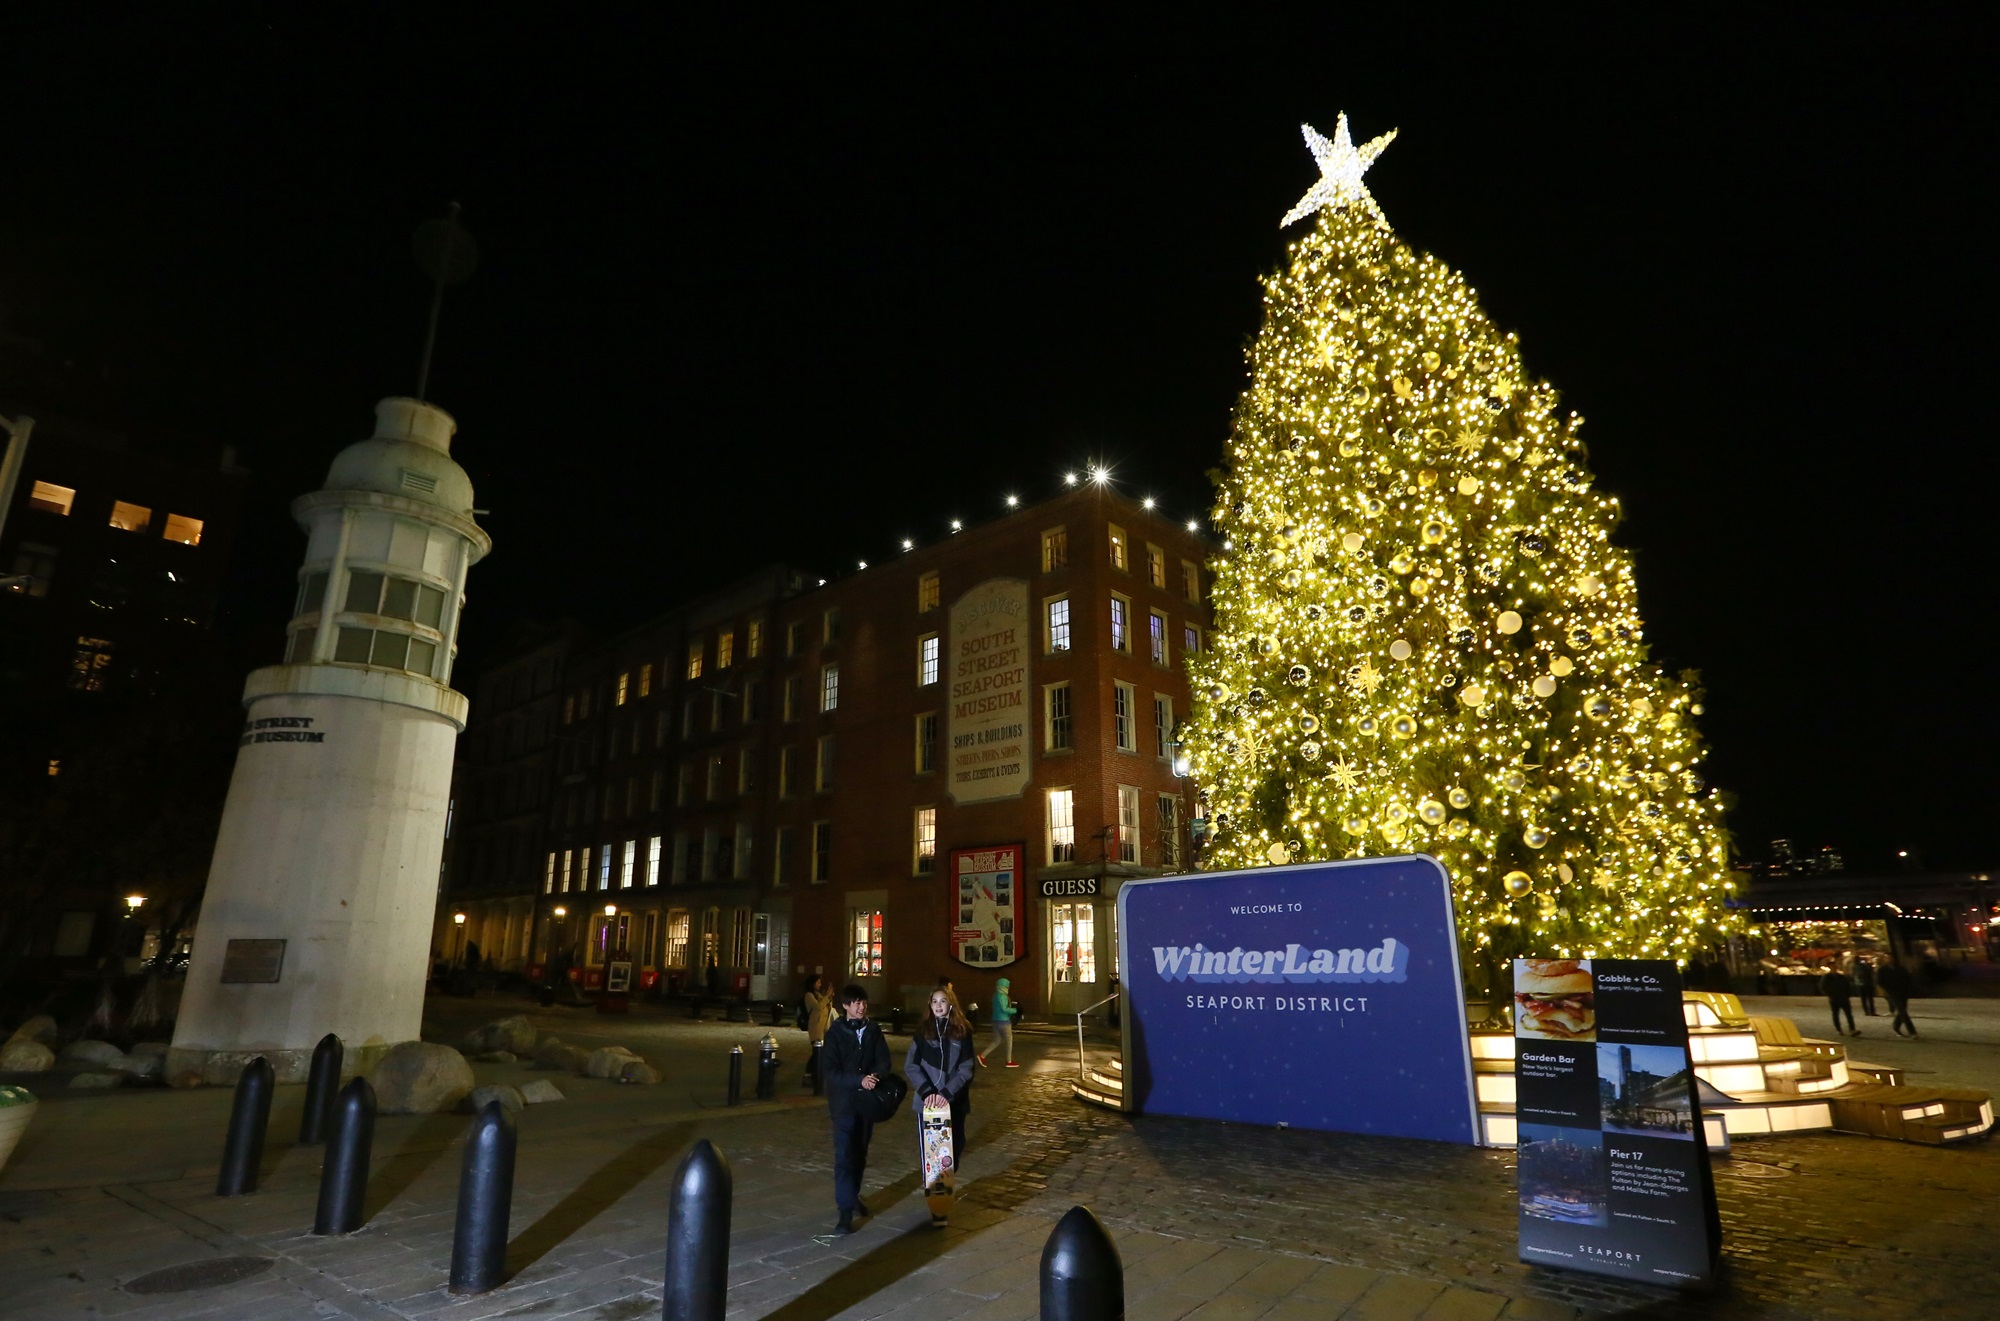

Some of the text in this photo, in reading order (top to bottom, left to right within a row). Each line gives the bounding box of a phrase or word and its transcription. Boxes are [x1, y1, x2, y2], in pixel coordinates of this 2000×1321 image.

[961, 628, 1016, 657] SOUTH
[957, 648, 1019, 677] STREET
[953, 668, 1025, 698] SEAPORT
[954, 690, 1022, 719] MUSEUM
[254, 731, 325, 743] MUSEUM
[954, 723, 1023, 749] SHIPS & BUILDINGS
[1043, 878, 1096, 896] GUESS
[1231, 903, 1302, 915] WELCOME TO
[1152, 937, 1408, 983] WinterLand
[1598, 974, 1632, 983] Cobble
[1642, 975, 1659, 984] Co.
[1186, 995, 1368, 1012] SEAPORT DISTRICT
[1522, 1052, 1575, 1064] Garden Bar
[1610, 1149, 1643, 1160] Pier 17
[1636, 1171, 1667, 1182] including
[1668, 1175, 1680, 1183] The
[1663, 1168, 1685, 1177] dining
[1611, 1176, 1632, 1184] Fulton
[1642, 1180, 1689, 1192] Jean-Georges
[1626, 1186, 1648, 1194] Malibu
[1579, 1245, 1641, 1262] SEAPORT
